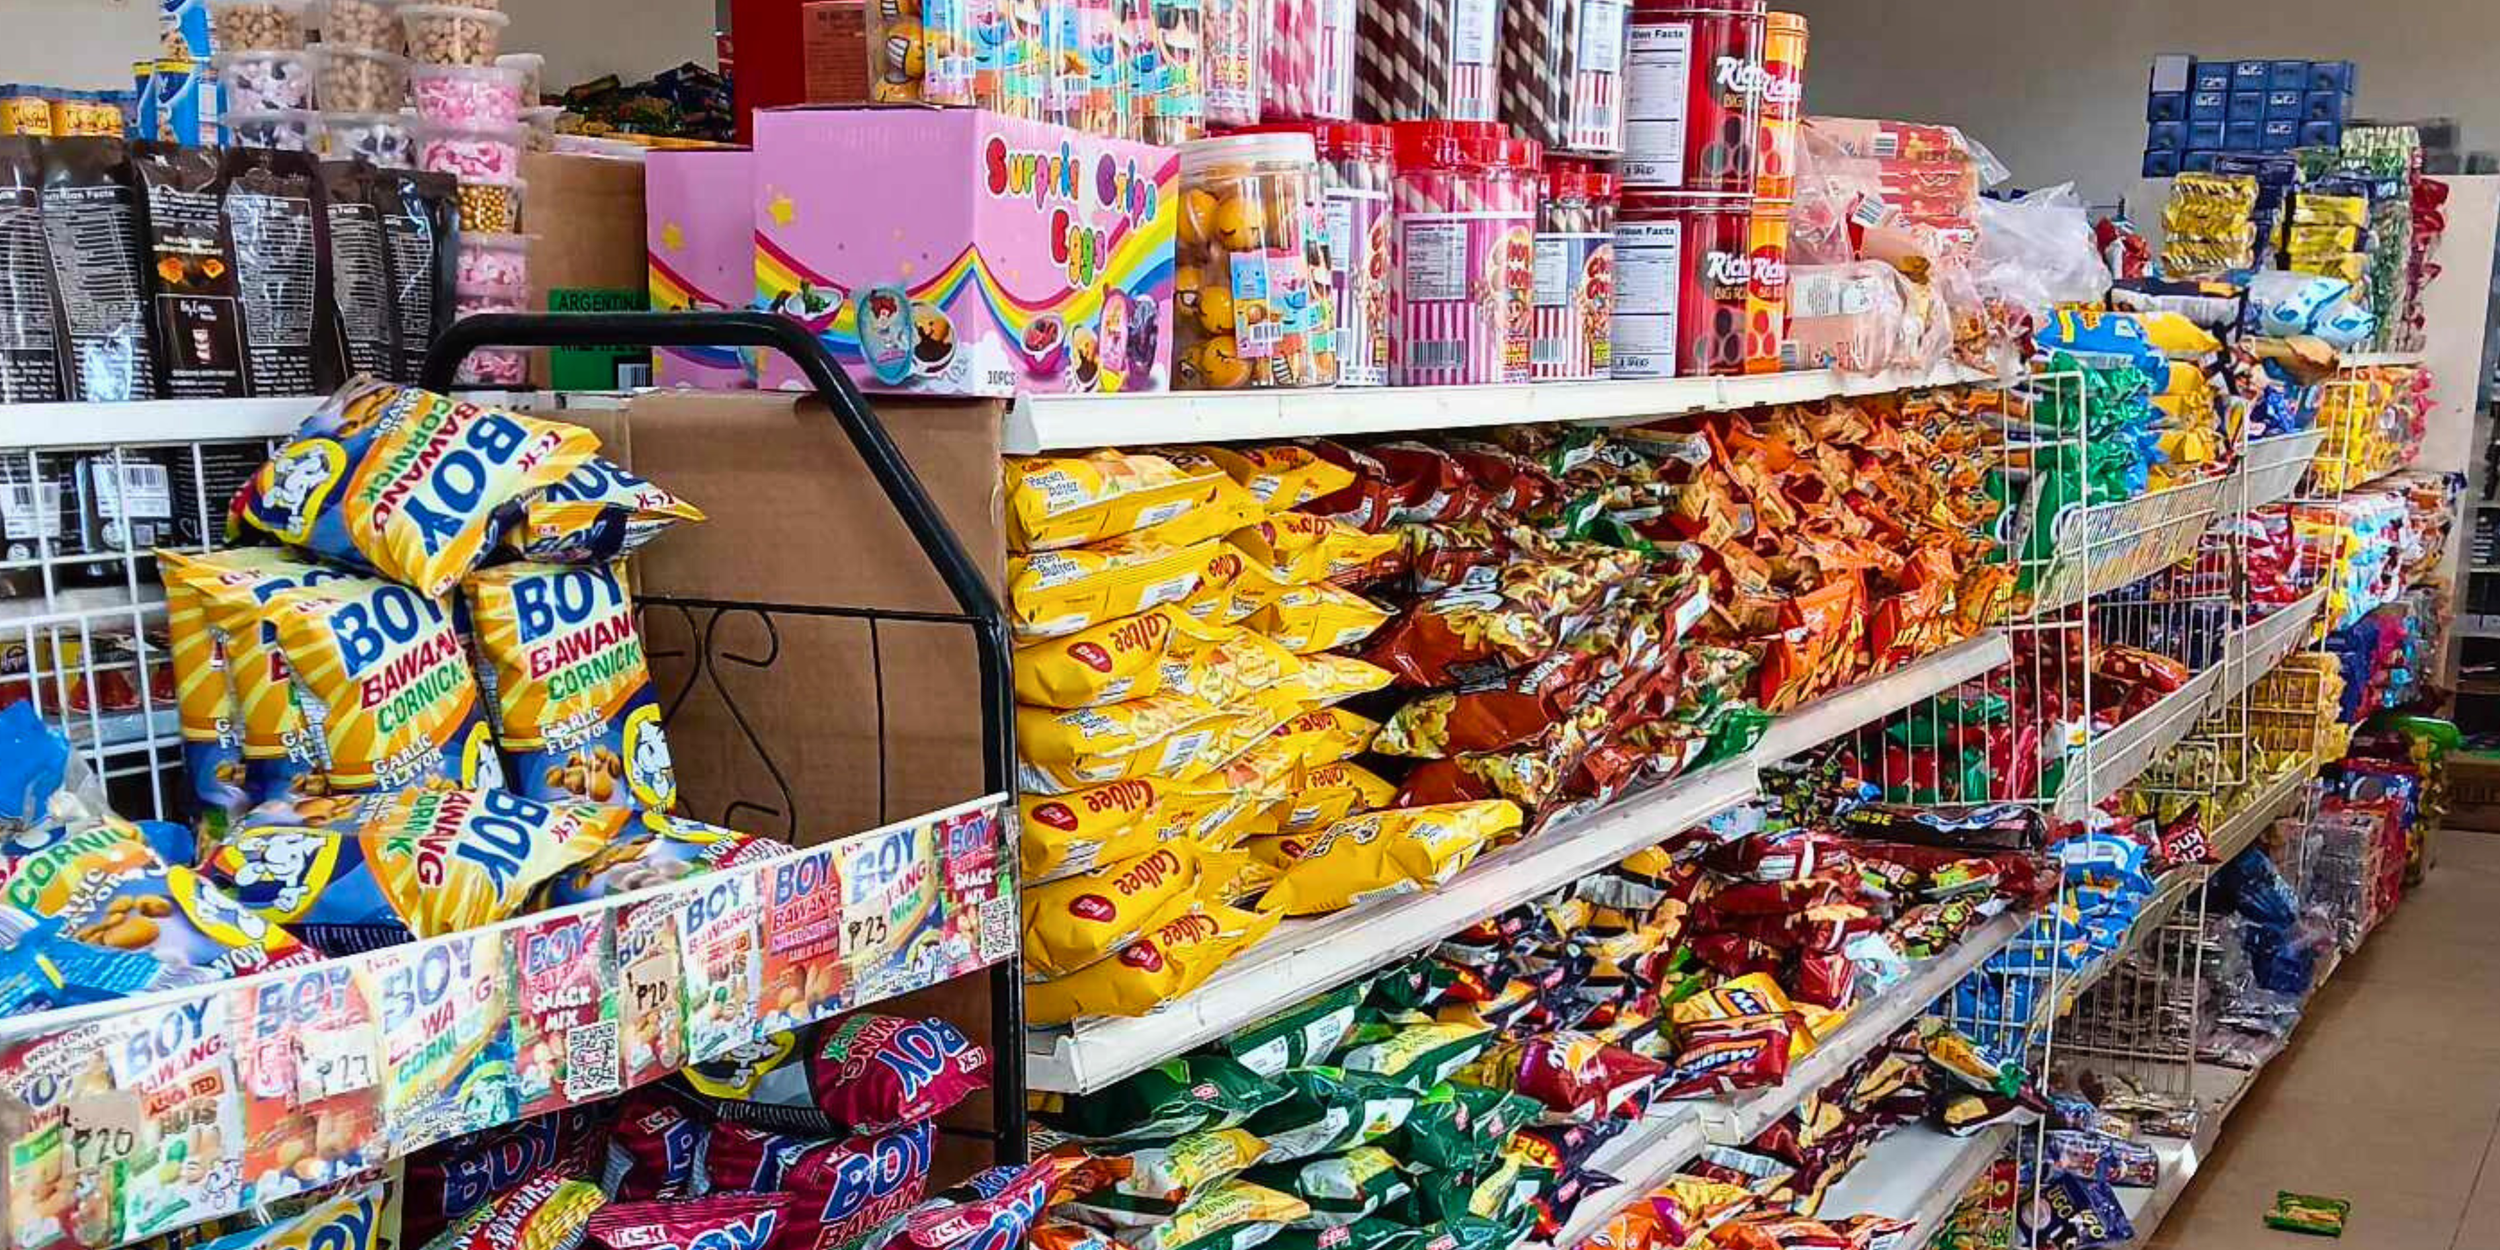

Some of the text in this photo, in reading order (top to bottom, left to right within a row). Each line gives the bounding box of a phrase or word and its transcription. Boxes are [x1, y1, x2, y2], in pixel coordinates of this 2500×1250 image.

[355, 398, 451, 507] CORNICK
[403, 412, 528, 558] BOY
[328, 583, 446, 680] BOY
[511, 563, 625, 644] BOY
[372, 735, 434, 776] GARLIC
[540, 706, 603, 739] GARLIC
[546, 724, 610, 757] FLAVOR
[378, 746, 445, 793] FLAVOR
[1080, 778, 1158, 815] Calbee
[454, 787, 551, 904] BOY
[849, 827, 918, 906] BOY
[950, 818, 990, 856] BOY
[685, 878, 743, 936] BOY
[774, 850, 834, 907] BOY
[1112, 849, 1182, 897] Calbee
[528, 922, 588, 975] BOY
[382, 937, 475, 1035] BOY
[125, 1000, 210, 1080] BOY
[876, 1016, 972, 1101] BOY
[820, 1117, 936, 1224] BOY
